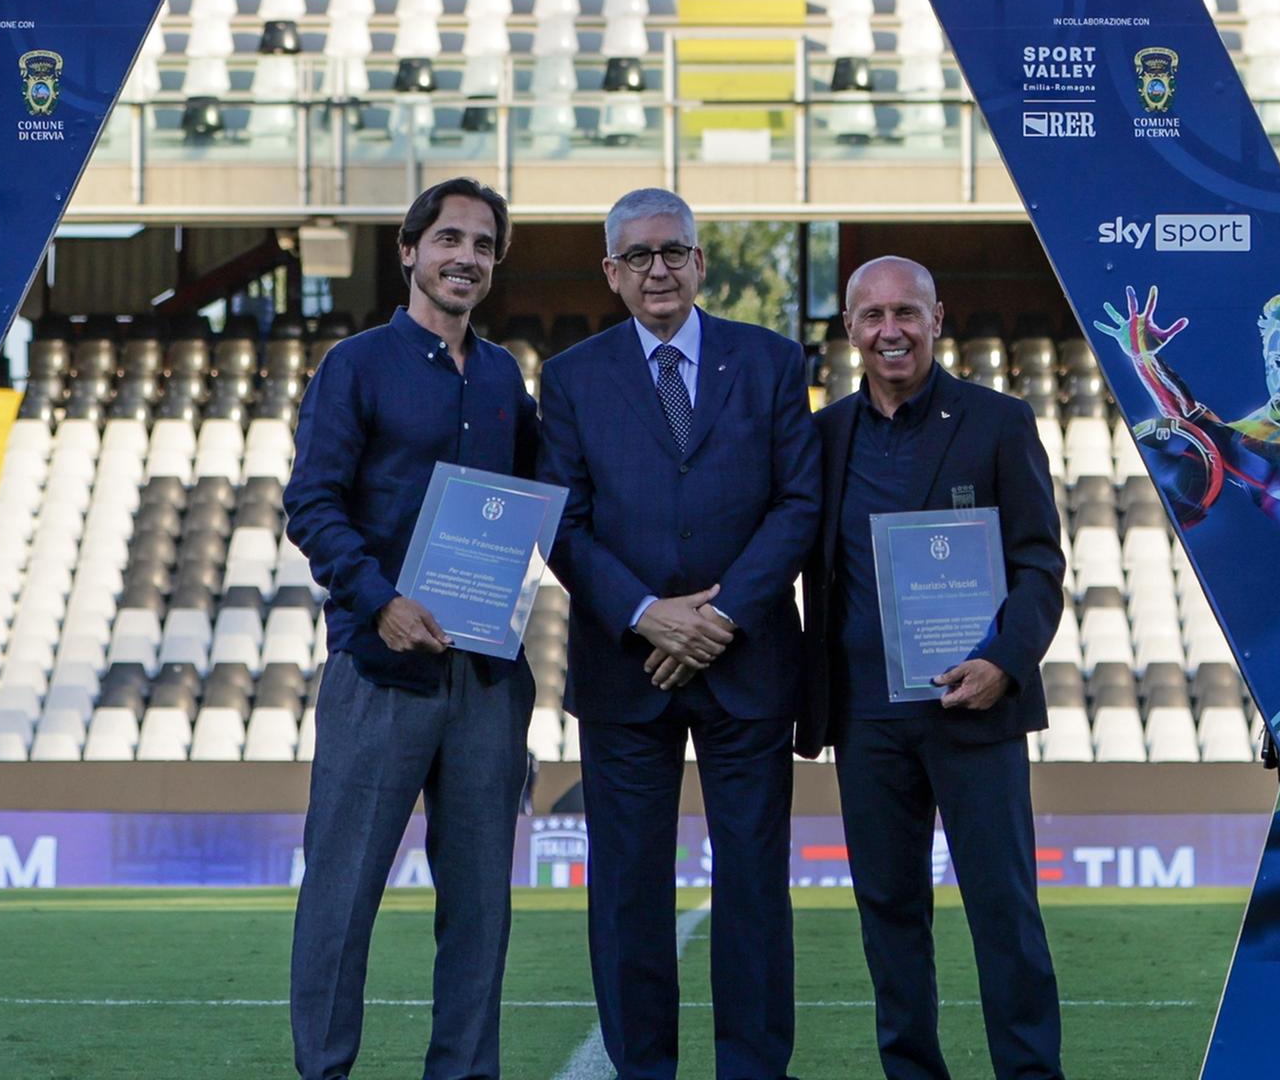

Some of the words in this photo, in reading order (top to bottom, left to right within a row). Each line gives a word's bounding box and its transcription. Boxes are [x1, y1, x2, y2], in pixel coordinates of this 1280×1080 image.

[18, 21, 35, 29] CON
[1063, 18, 1132, 26] COLLABORAZIONE
[1133, 18, 1150, 26] CON
[1024, 47, 1096, 62] SPORT
[1023, 65, 1096, 78] VALLEY
[1024, 84, 1096, 93] Emilia-Romagna
[18, 121, 64, 130] COMUNE
[1134, 118, 1180, 127] COMUNE
[19, 132, 29, 140] DI
[30, 132, 64, 141] CERVIA
[1135, 129, 1144, 137] DI
[1146, 129, 1180, 138] CERVIA
[1098, 216, 1151, 249] sky
[1163, 221, 1243, 247] sport
[1073, 846, 1195, 887] TIM
